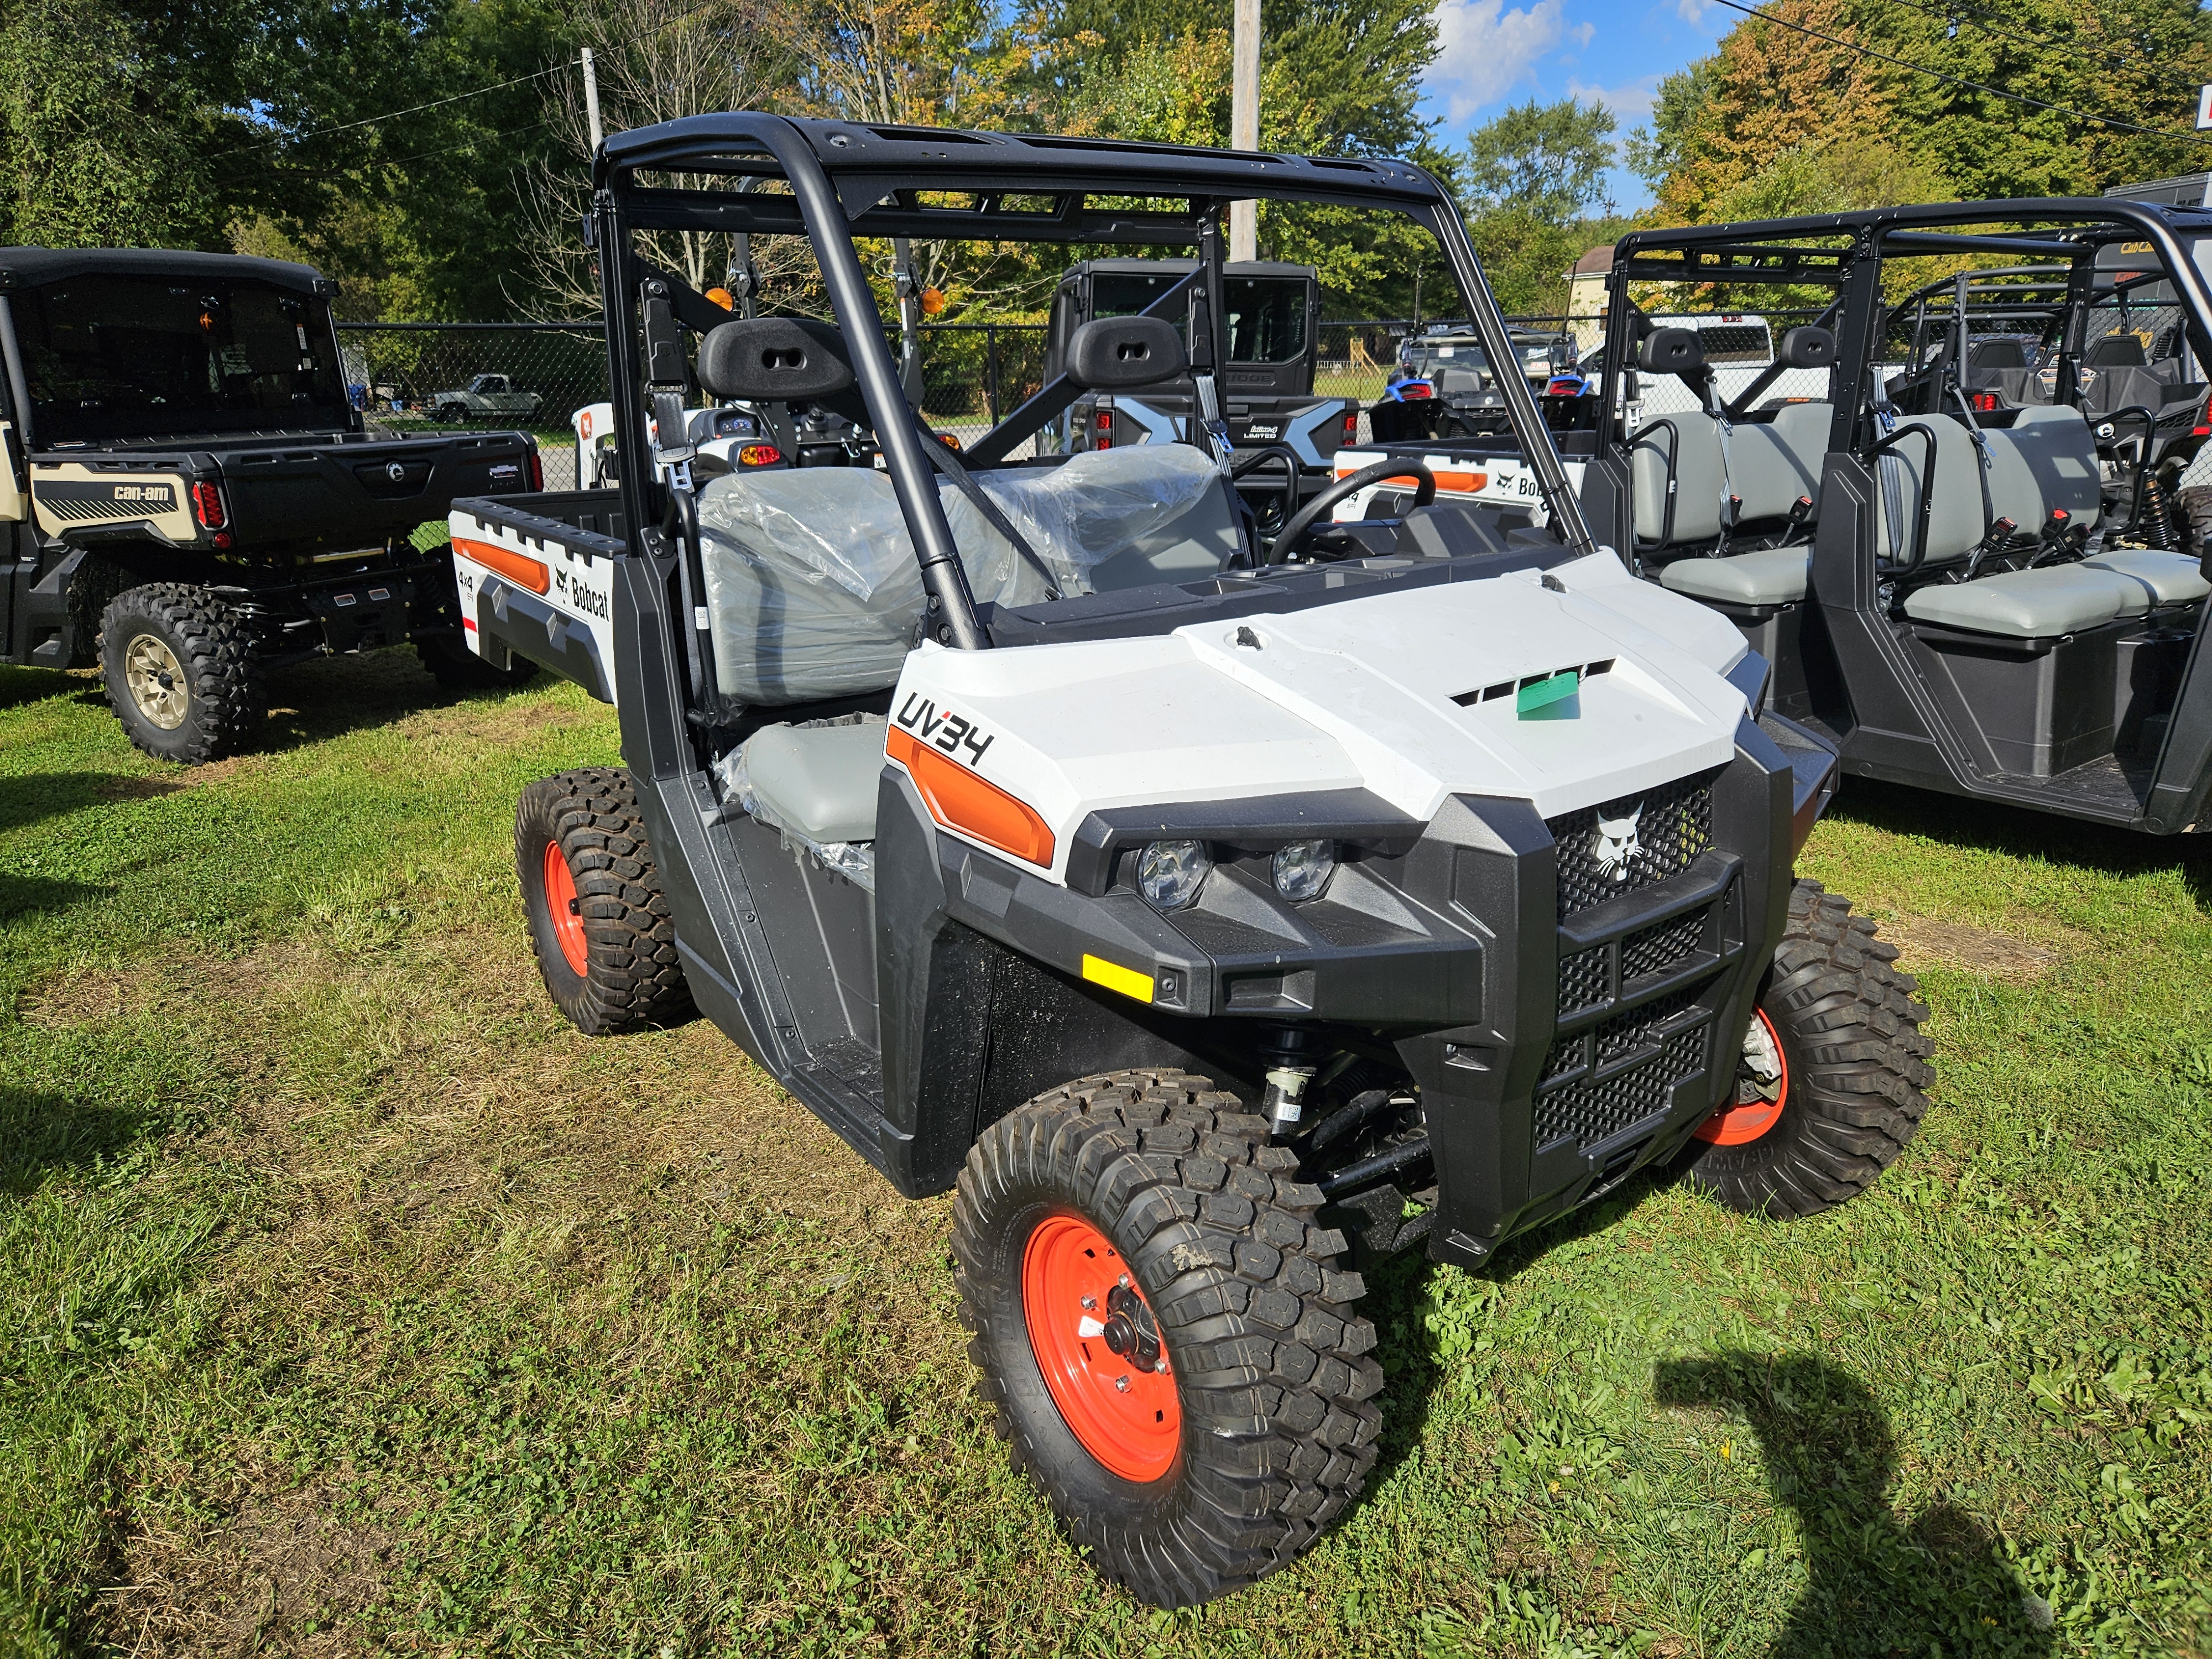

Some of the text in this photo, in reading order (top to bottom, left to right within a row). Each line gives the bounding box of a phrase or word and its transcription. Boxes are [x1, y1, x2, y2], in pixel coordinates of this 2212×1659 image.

[458, 571, 473, 592] 4x4
[571, 576, 609, 622] Bobcat
[897, 691, 995, 767] UV34
